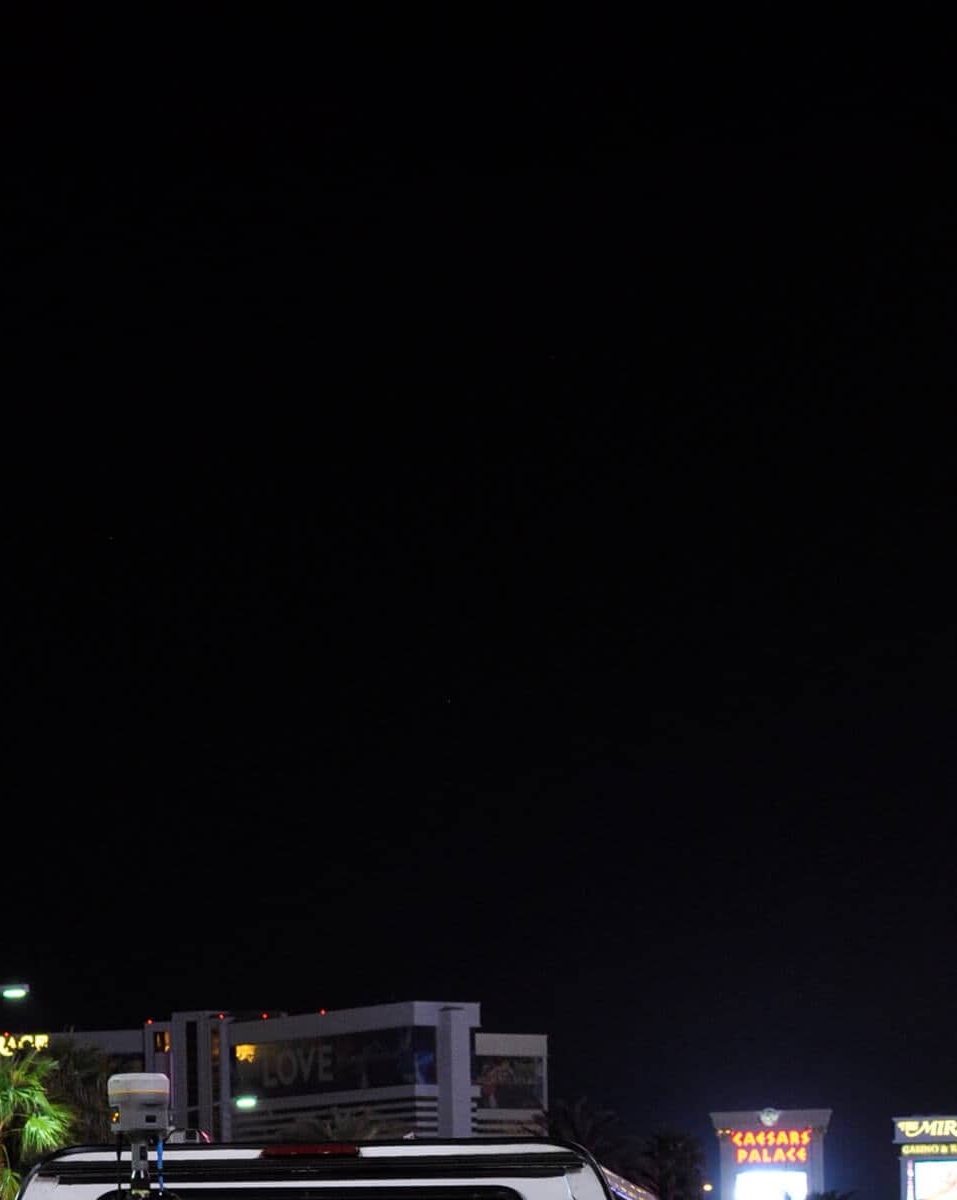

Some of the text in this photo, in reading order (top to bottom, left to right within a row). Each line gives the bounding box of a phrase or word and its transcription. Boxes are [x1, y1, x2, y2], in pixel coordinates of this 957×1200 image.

[263, 1046, 334, 1088] LOVE
[732, 1130, 810, 1146] CAESARS
[737, 1147, 807, 1163] PALACE
